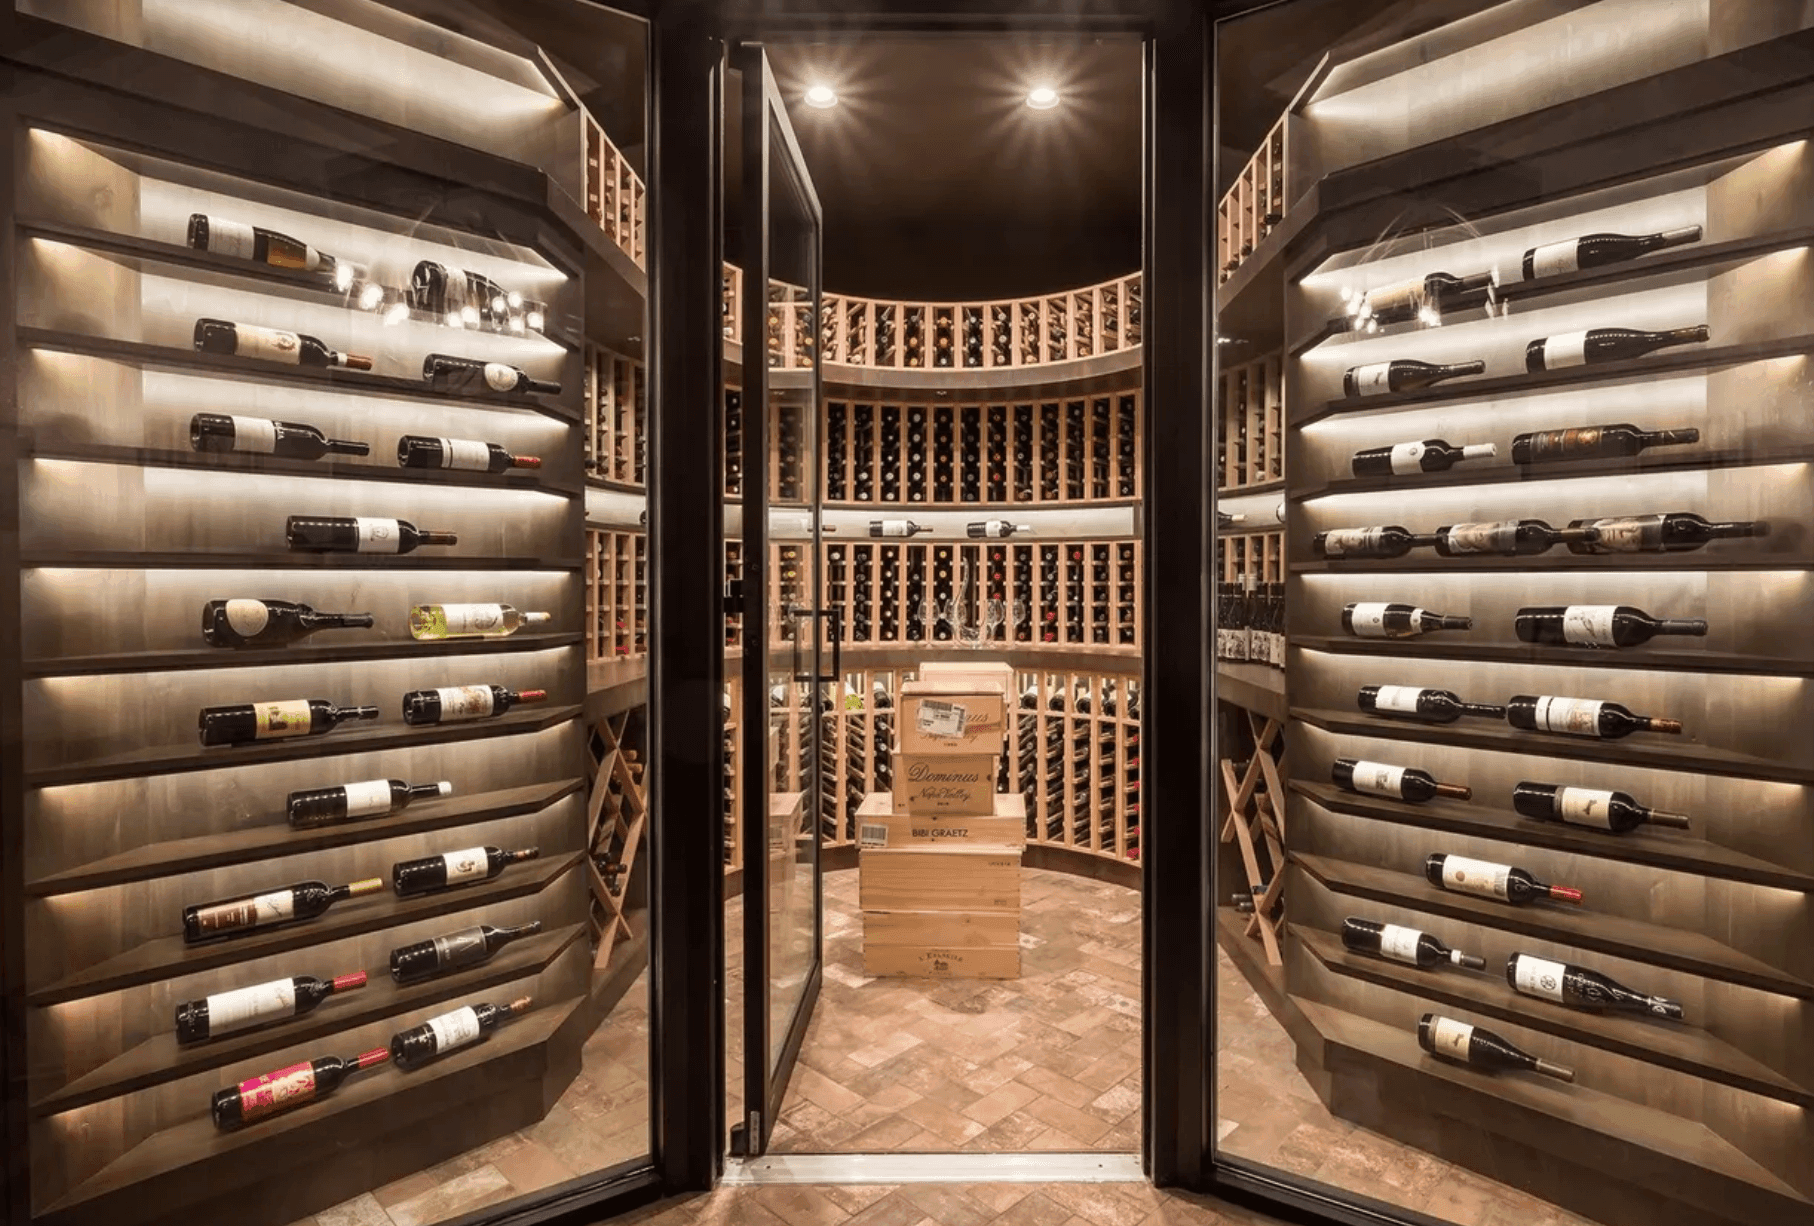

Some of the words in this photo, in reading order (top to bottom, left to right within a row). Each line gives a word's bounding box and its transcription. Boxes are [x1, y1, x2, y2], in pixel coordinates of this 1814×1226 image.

[908, 762, 979, 783] Dominus
[940, 787, 971, 803] Valley
[912, 828, 930, 838] BIBI
[931, 828, 969, 838] GRAETZ
